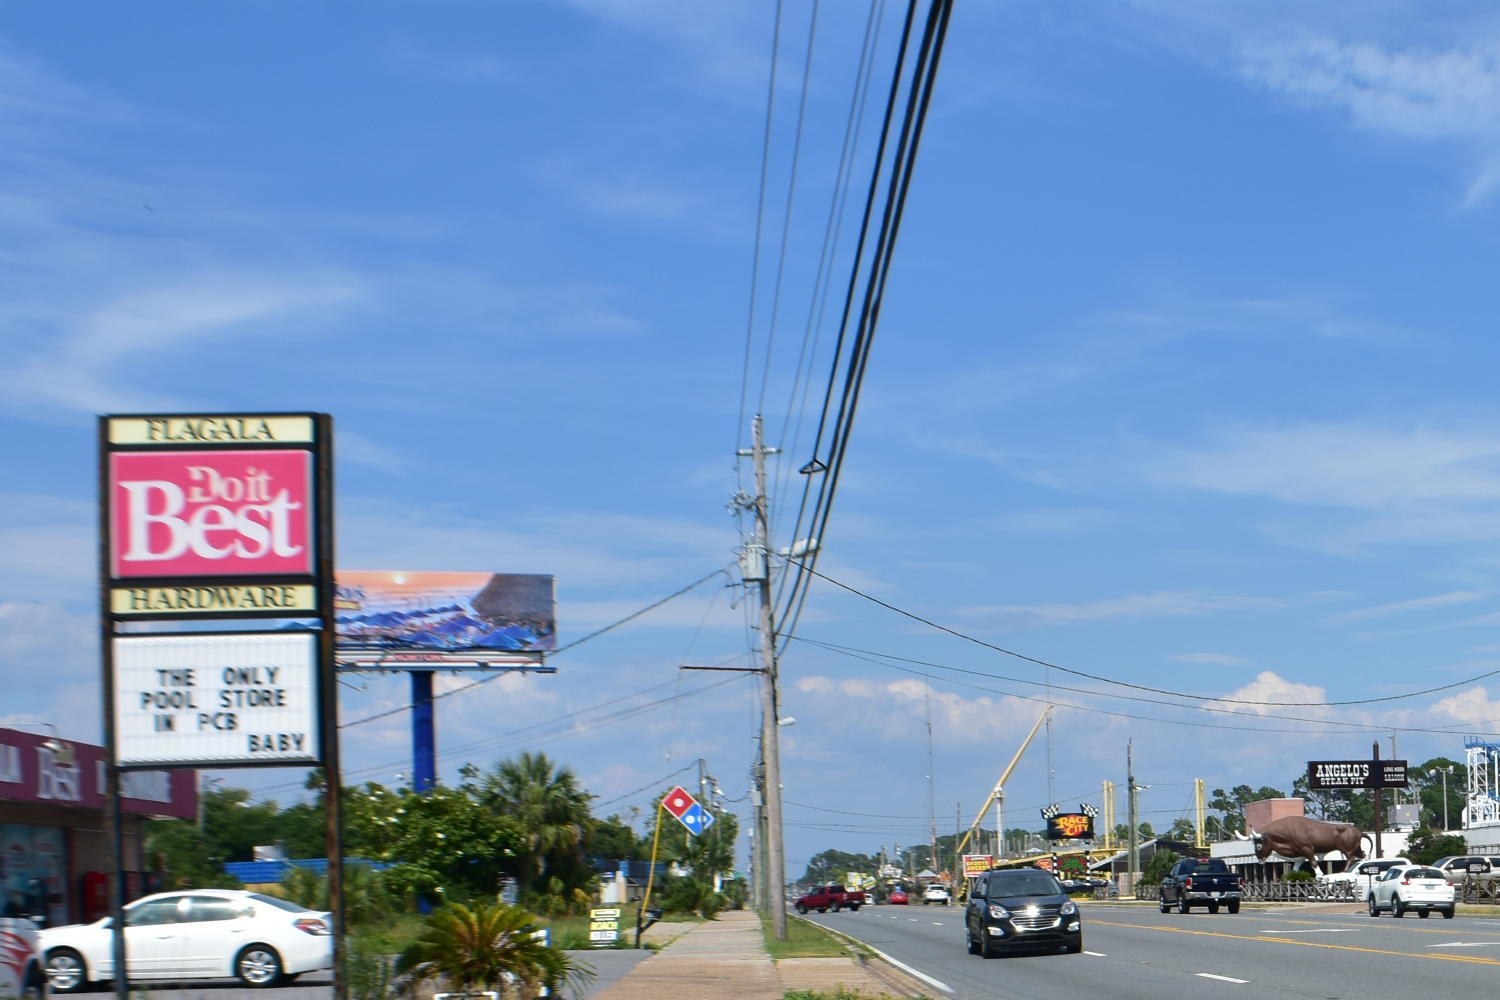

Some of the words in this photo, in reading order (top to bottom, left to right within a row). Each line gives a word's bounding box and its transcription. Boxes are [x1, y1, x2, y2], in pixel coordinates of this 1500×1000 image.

[146, 418, 276, 441] FLAGALA
[186, 466, 243, 502] Do
[246, 467, 273, 502] it
[117, 480, 304, 561] Best
[126, 586, 297, 611] HARDWARE
[156, 668, 196, 687] THE
[223, 666, 280, 686] ONLY
[141, 691, 198, 709] POOL
[219, 688, 286, 708] STORE
[154, 714, 175, 732] IN
[197, 712, 239, 731] PCB
[247, 733, 306, 752] BABY
[1315, 764, 1370, 778] ANGELO'S
[1320, 777, 1349, 786] STEAK
[1350, 777, 1366, 785] PIT
[1056, 816, 1088, 827] RACE
[1064, 824, 1089, 836] CITY
